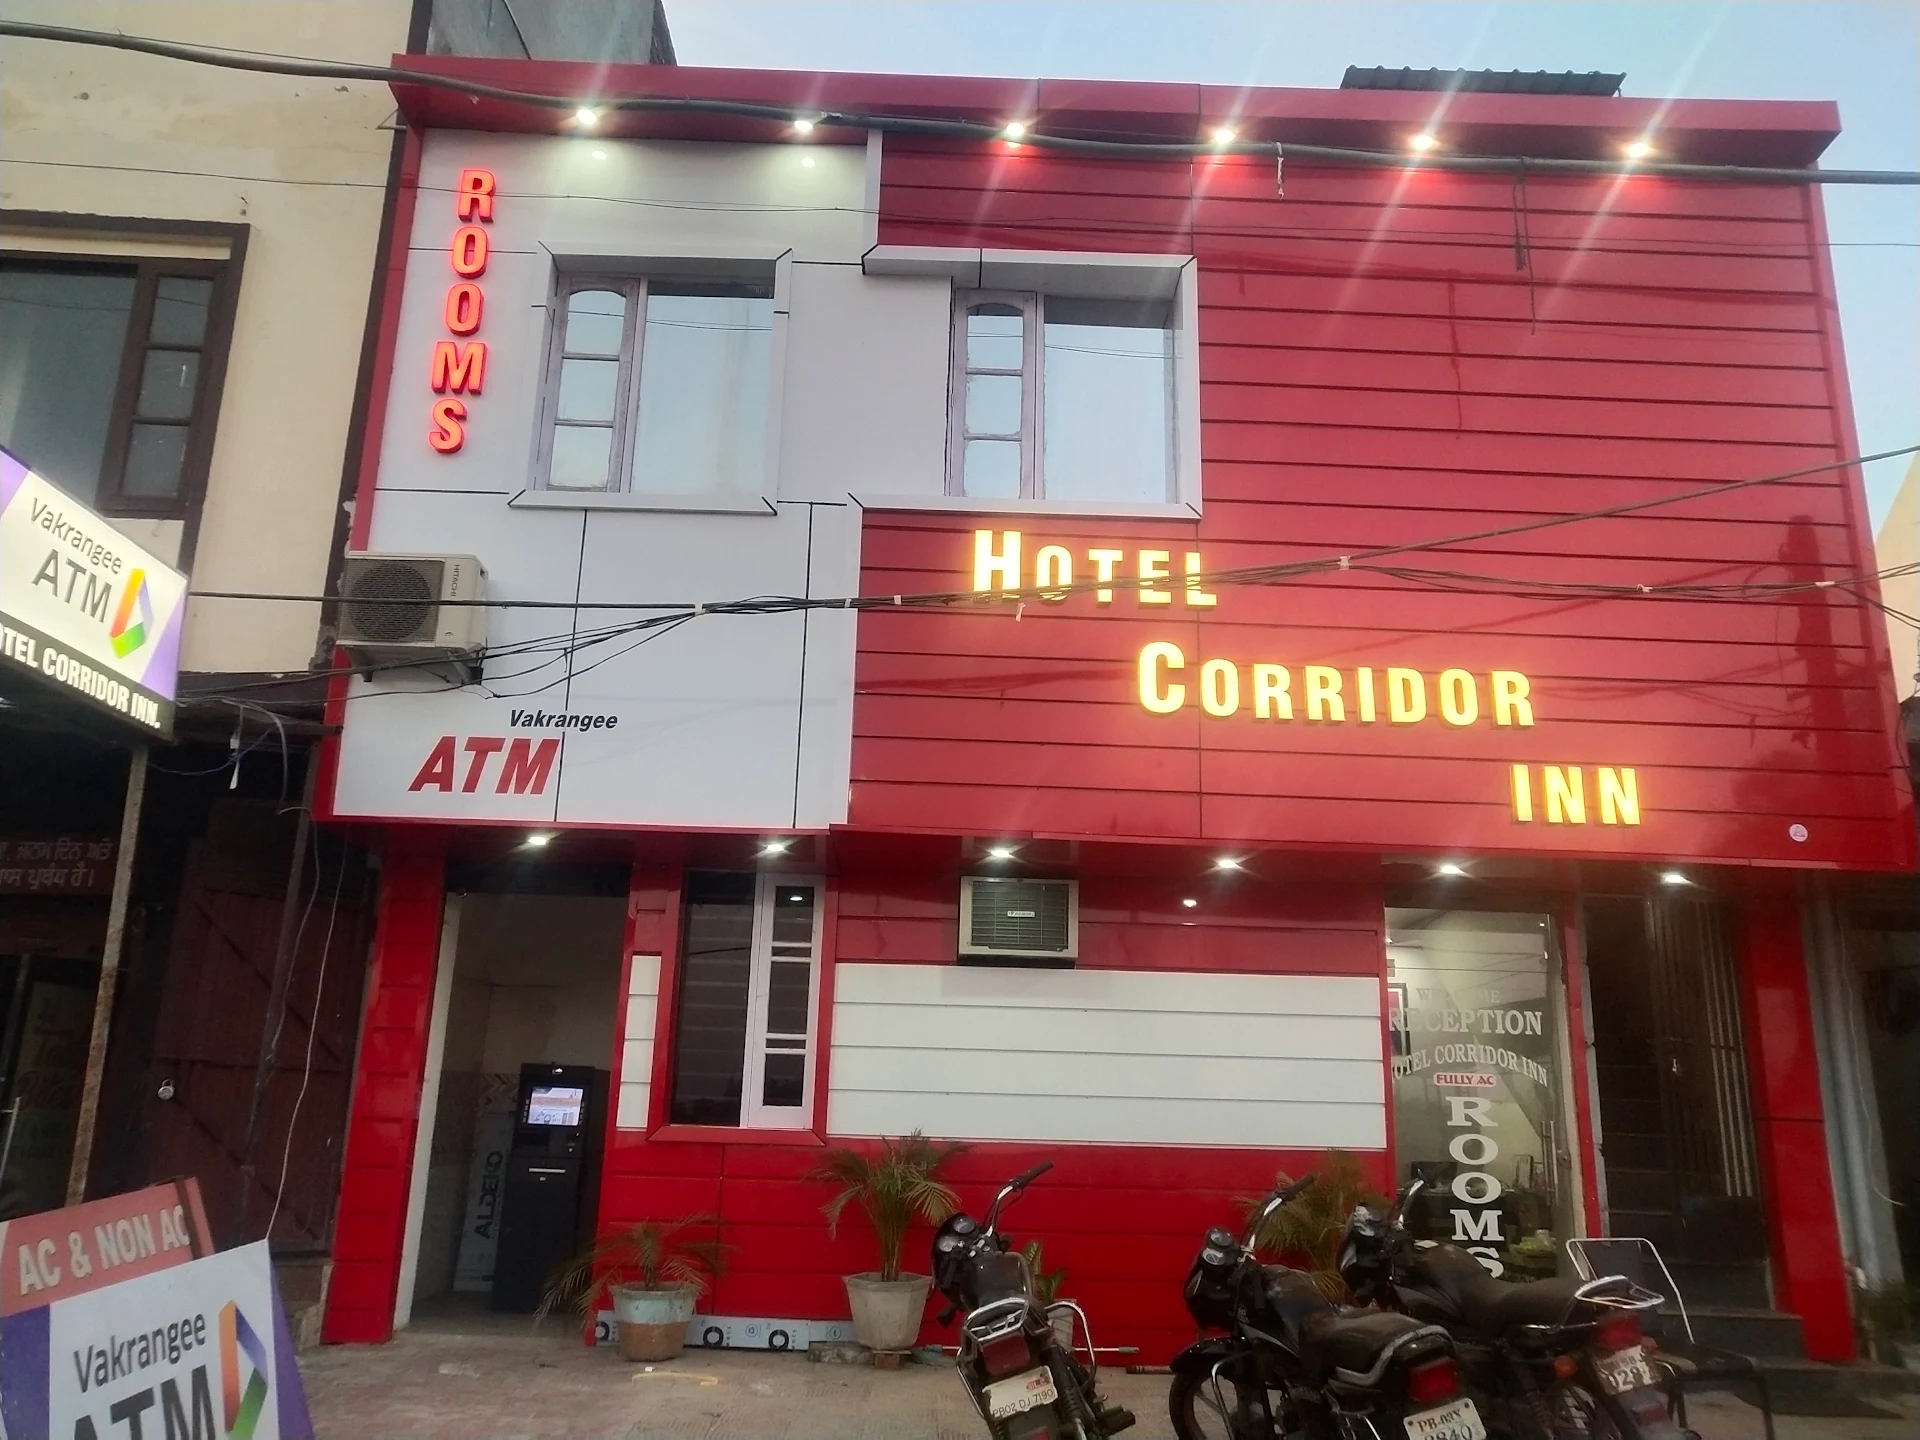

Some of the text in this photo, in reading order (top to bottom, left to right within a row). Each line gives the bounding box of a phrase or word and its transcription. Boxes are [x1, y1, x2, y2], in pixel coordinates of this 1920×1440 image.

[428, 169, 495, 453] ROOMS
[30, 497, 122, 575] Vakrangee
[31, 549, 112, 624] ATM
[451, 564, 460, 597] HITACHI
[0, 622, 161, 728] TEL CORRIDOR INN.
[509, 709, 618, 732] Vakrangee
[407, 736, 560, 795] ATM
[1509, 764, 1640, 825] INN
[1388, 1007, 1543, 1036] RECEPTION
[1434, 1043, 1520, 1073] CORRIDOR
[1521, 1056, 1548, 1087] INN
[1436, 1074, 1495, 1085] FULLY AC
[1445, 1096, 1505, 1279] ROOMS
[17, 1204, 191, 1296] AC & NON AC
[73, 1312, 206, 1393] Vakrangee
[992, 1402, 1018, 1418] PB02
[1031, 1388, 1054, 1403] 7190
